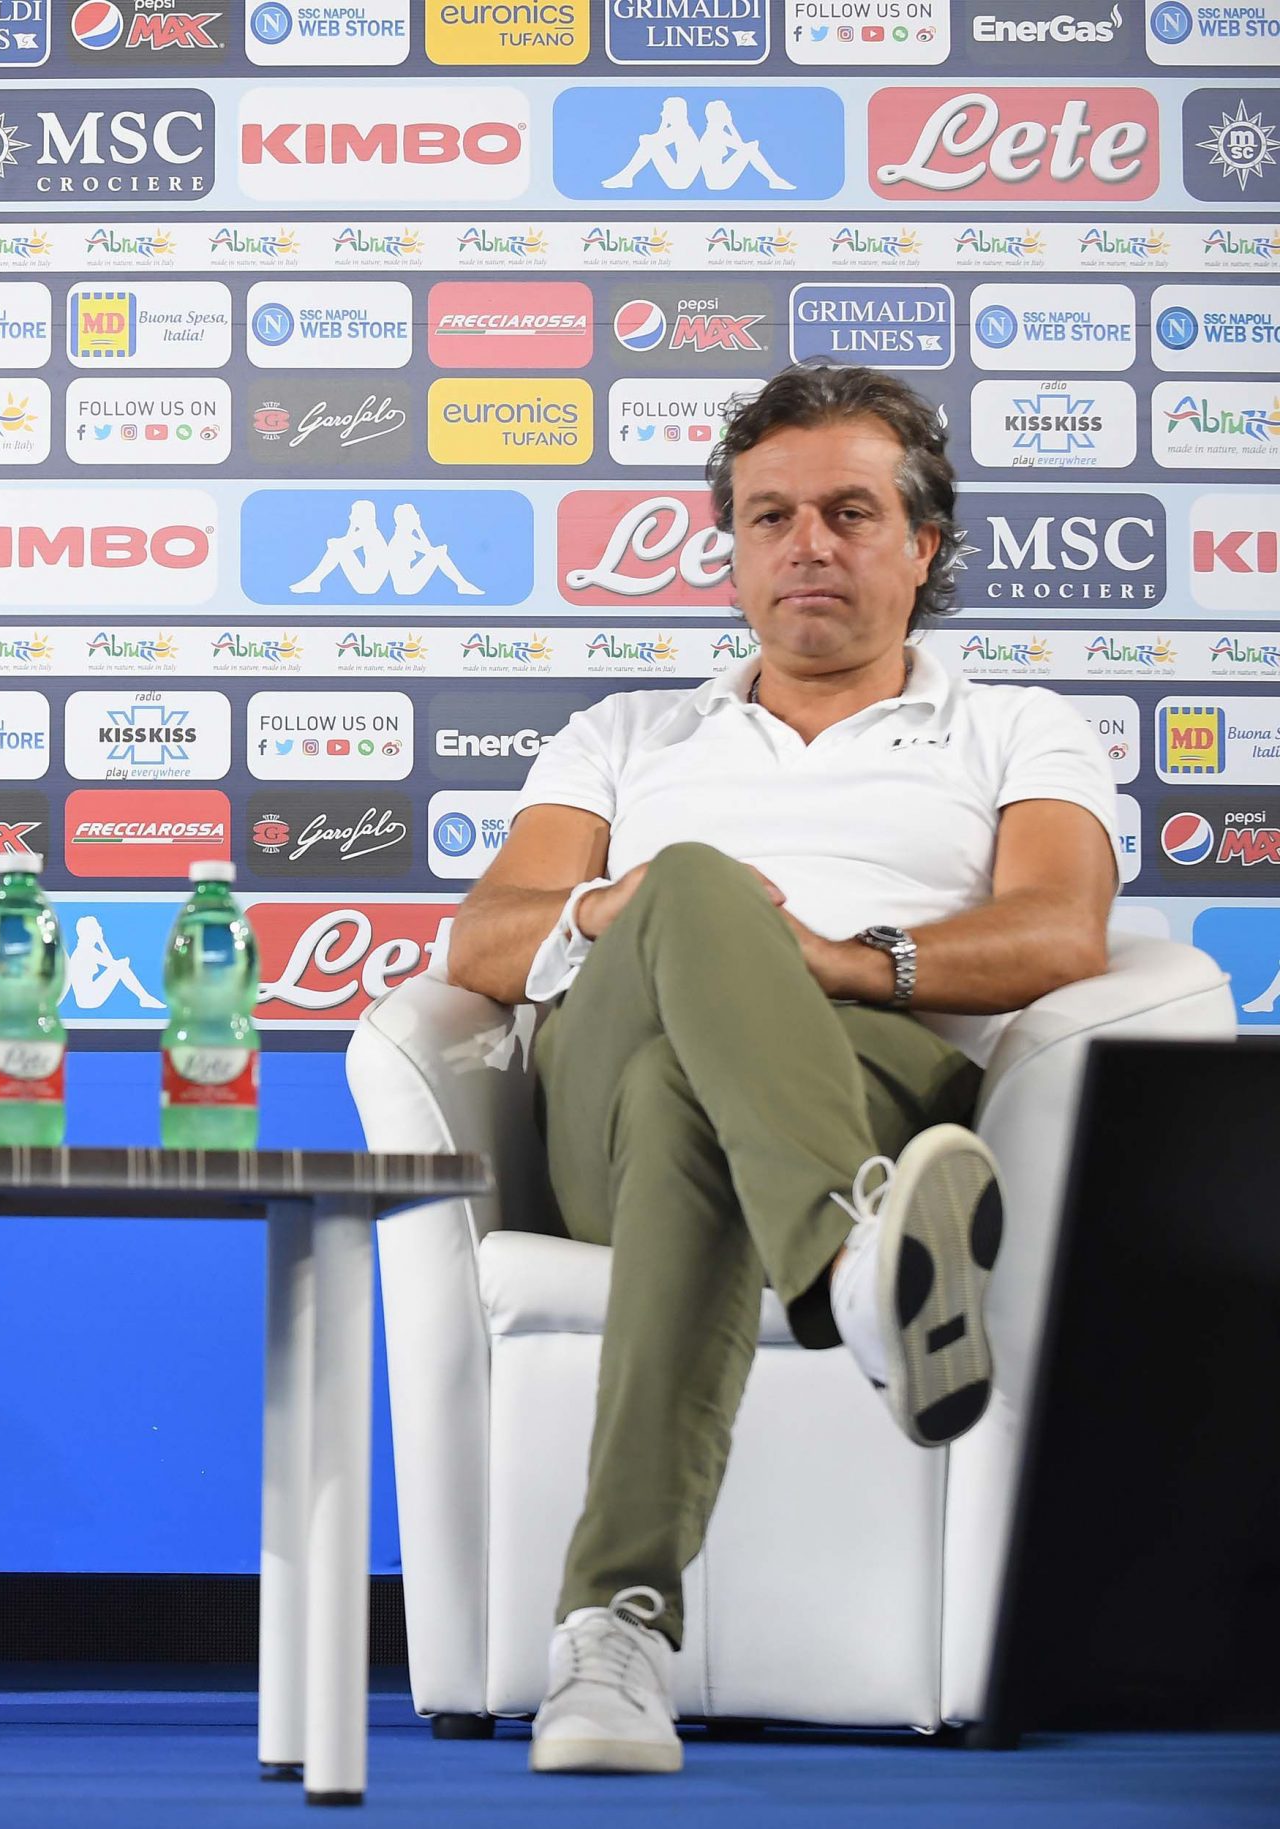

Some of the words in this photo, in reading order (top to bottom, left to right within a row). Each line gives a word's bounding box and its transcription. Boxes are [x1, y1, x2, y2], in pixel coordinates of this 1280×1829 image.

[298, 8, 320, 19] SSC
[324, 8, 365, 19] NAPOLI
[441, 0, 574, 24] euronics
[614, 0, 761, 18] GRIMALDI
[124, 12, 220, 50] MAX
[298, 20, 340, 36] WEB
[345, 20, 405, 36] STORE
[973, 15, 1114, 42] EnerGas
[499, 32, 574, 46] TUFANO
[646, 26, 729, 47] LINES
[37, 111, 203, 164] MSC
[241, 122, 521, 165] KIMBO
[877, 93, 1147, 191] Lete
[37, 176, 204, 192] CROCIERE
[678, 297, 718, 312] pepsi
[139, 311, 182, 323] Buona
[186, 311, 228, 326] Spesa,
[438, 314, 587, 328] FRECCIAROSSA
[798, 301, 946, 325] GRIMALDI
[1023, 312, 1046, 323] SSC
[1049, 312, 1090, 323] NAPOLI
[82, 312, 126, 335] MD
[163, 329, 204, 341] Italia!
[668, 315, 766, 352] MAX
[831, 330, 914, 351] LINES
[1023, 324, 1066, 341] WEB
[1071, 324, 1131, 341] STORE
[1041, 382, 1067, 390] radio
[79, 401, 154, 416] FOLLOW
[161, 401, 184, 416] US
[191, 401, 216, 416] ON
[443, 397, 578, 424] euronics
[622, 402, 698, 417] FOLLOW
[14, 440, 34, 452] Italy
[502, 432, 578, 446] TUFANO
[1012, 455, 1035, 466] play
[1037, 456, 1097, 466] everywhere
[987, 516, 1154, 571] MSC
[988, 583, 1156, 599] CROCIERE
[261, 716, 336, 731] FOLLOW
[343, 716, 366, 731] US
[373, 716, 398, 731] ON
[1171, 727, 1214, 750] MD
[1225, 810, 1266, 825] pepsi
[75, 823, 224, 837] FRECCIAROSSA
